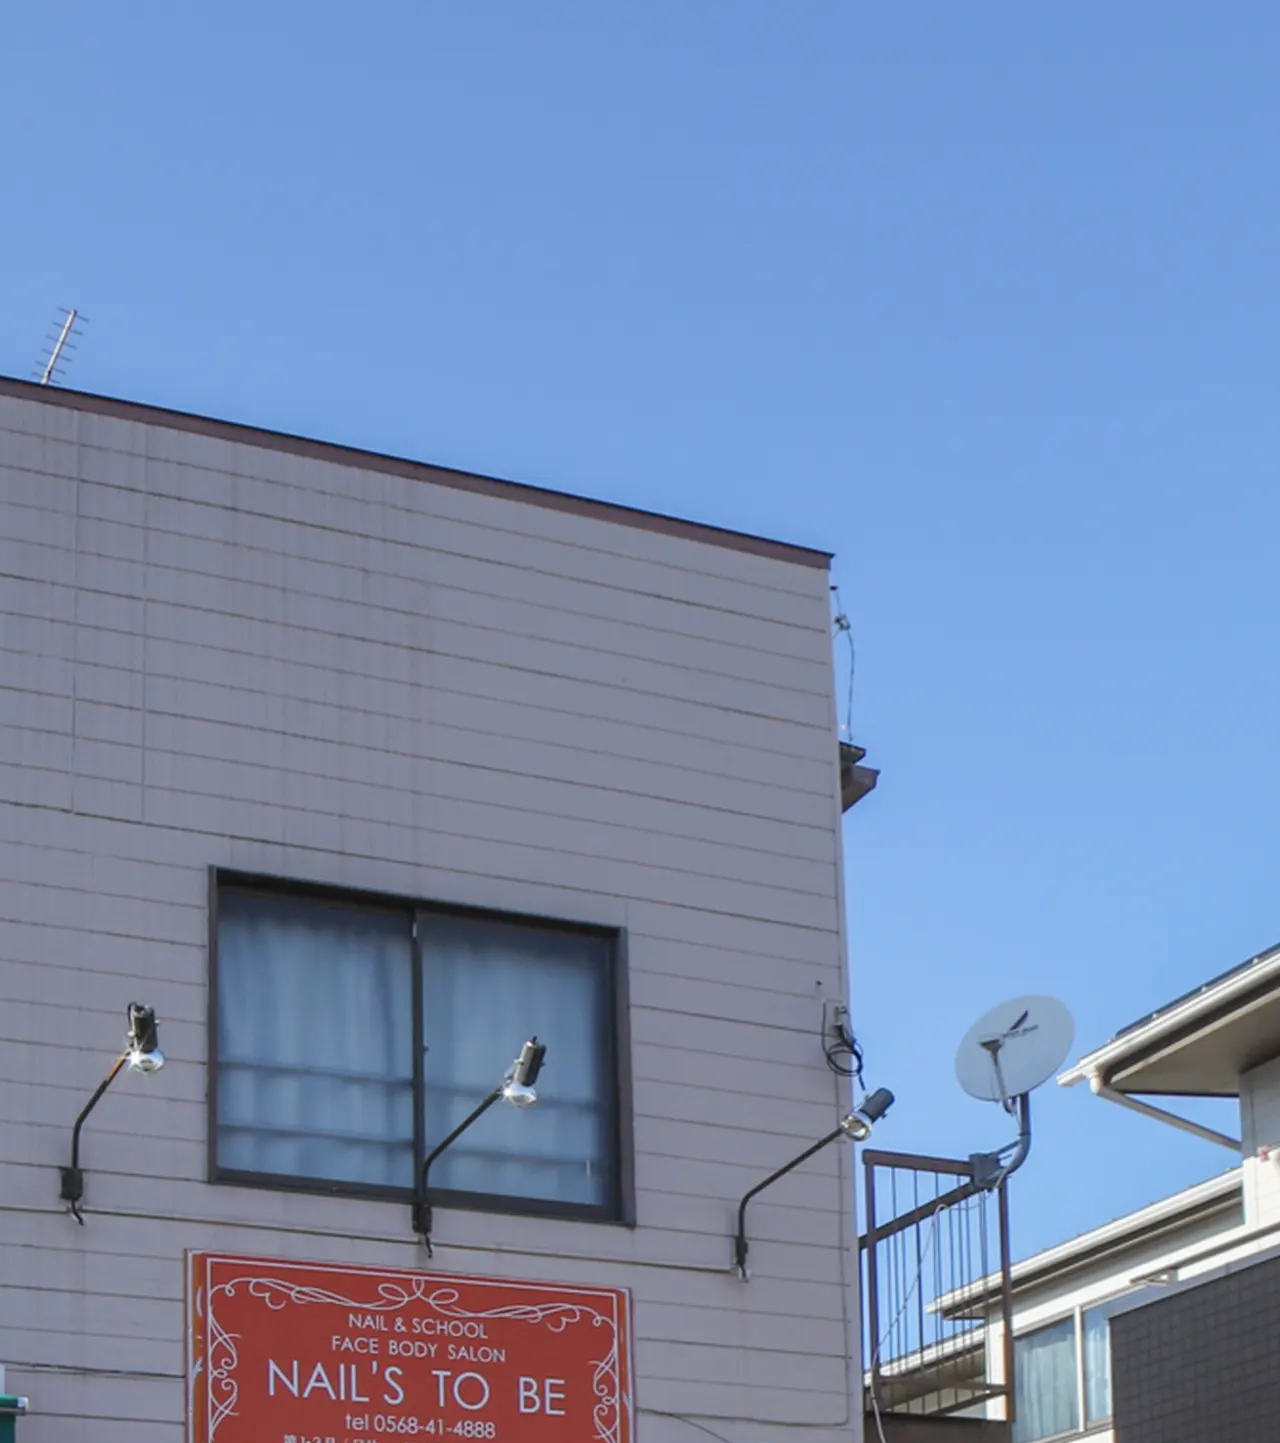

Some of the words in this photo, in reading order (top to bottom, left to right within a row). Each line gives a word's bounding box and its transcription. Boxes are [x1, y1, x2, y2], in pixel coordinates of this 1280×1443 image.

[349, 1314, 389, 1332] NAIL
[394, 1317, 407, 1333] &
[412, 1318, 489, 1340] SCHOOL
[332, 1336, 379, 1354] FACE
[389, 1340, 438, 1358] BODY
[448, 1344, 506, 1363] SALON
[269, 1360, 405, 1405] NAIL'S
[432, 1370, 490, 1410] TO
[519, 1377, 566, 1416] BE
[346, 1414, 369, 1431] tel
[374, 1415, 496, 1440] 0568-41-4888
